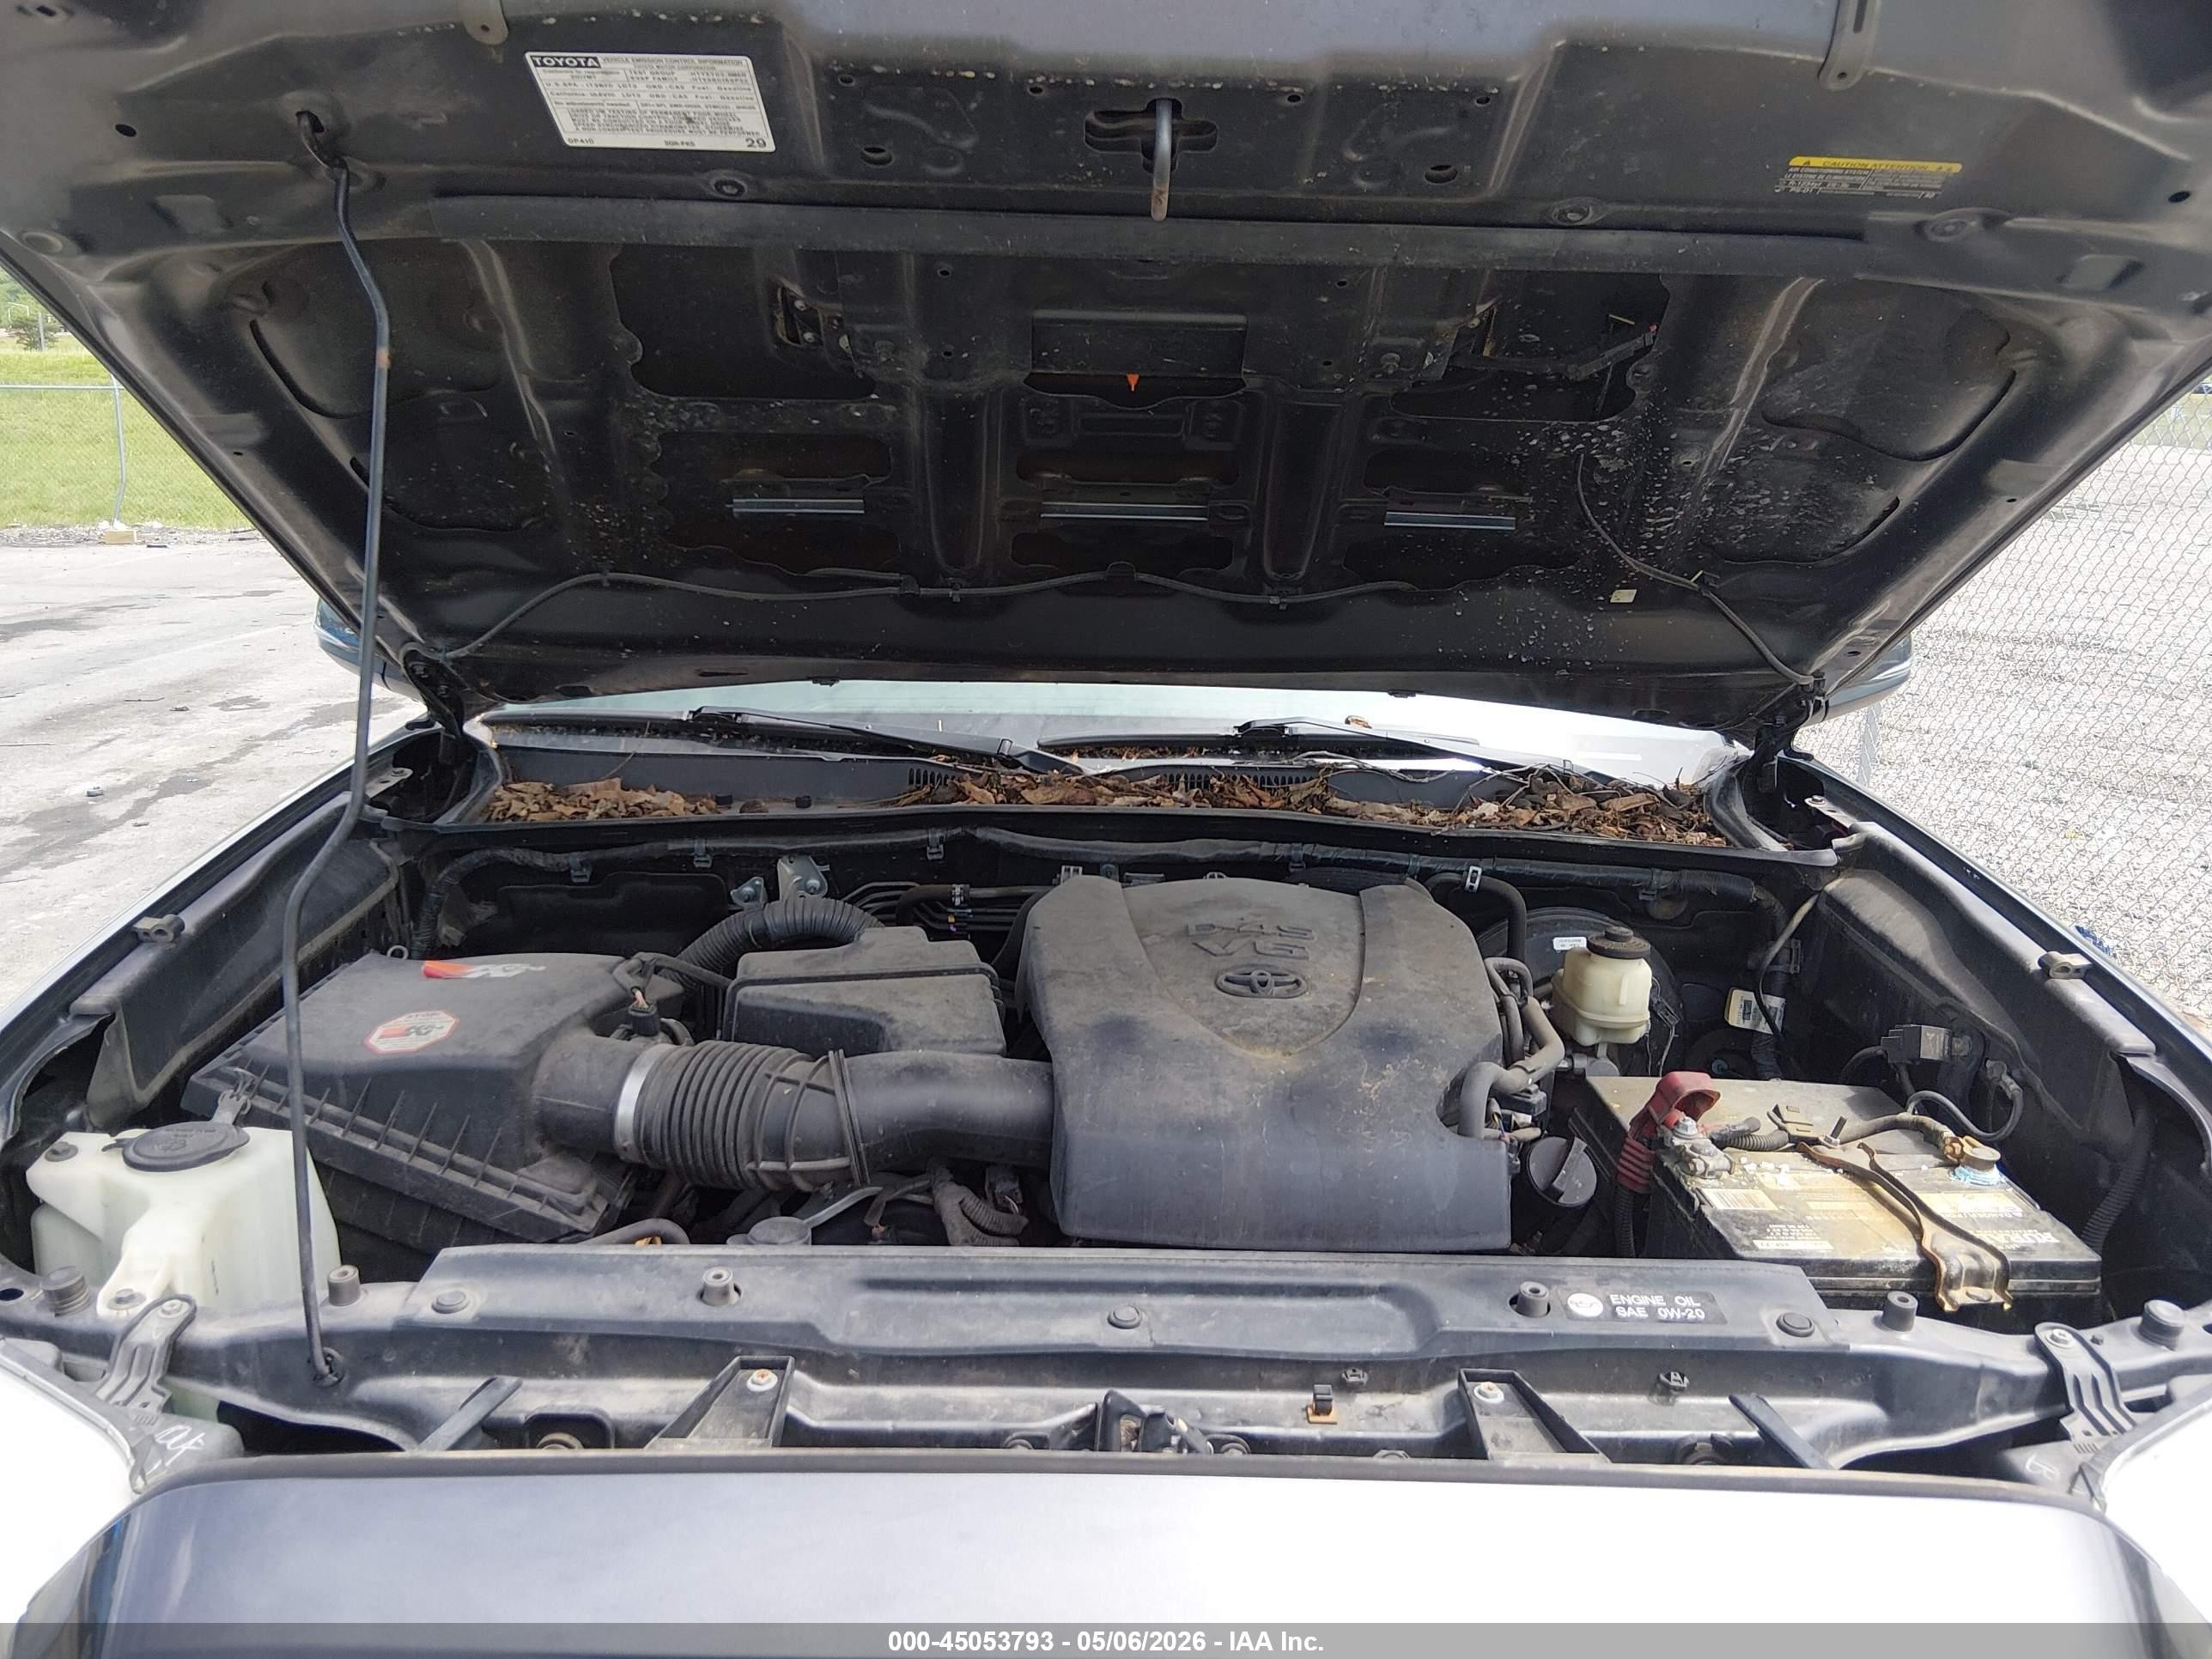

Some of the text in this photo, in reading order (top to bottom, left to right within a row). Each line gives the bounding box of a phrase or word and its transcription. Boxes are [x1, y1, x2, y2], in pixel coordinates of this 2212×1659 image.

[532, 56, 599, 68] TOYOTA
[745, 137, 768, 149] 29
[1821, 160, 1929, 171] CAUTION ATTENTION
[1609, 1294, 1701, 1308] ENGINE OIL
[1615, 1306, 1705, 1320] SAE 0W-20
